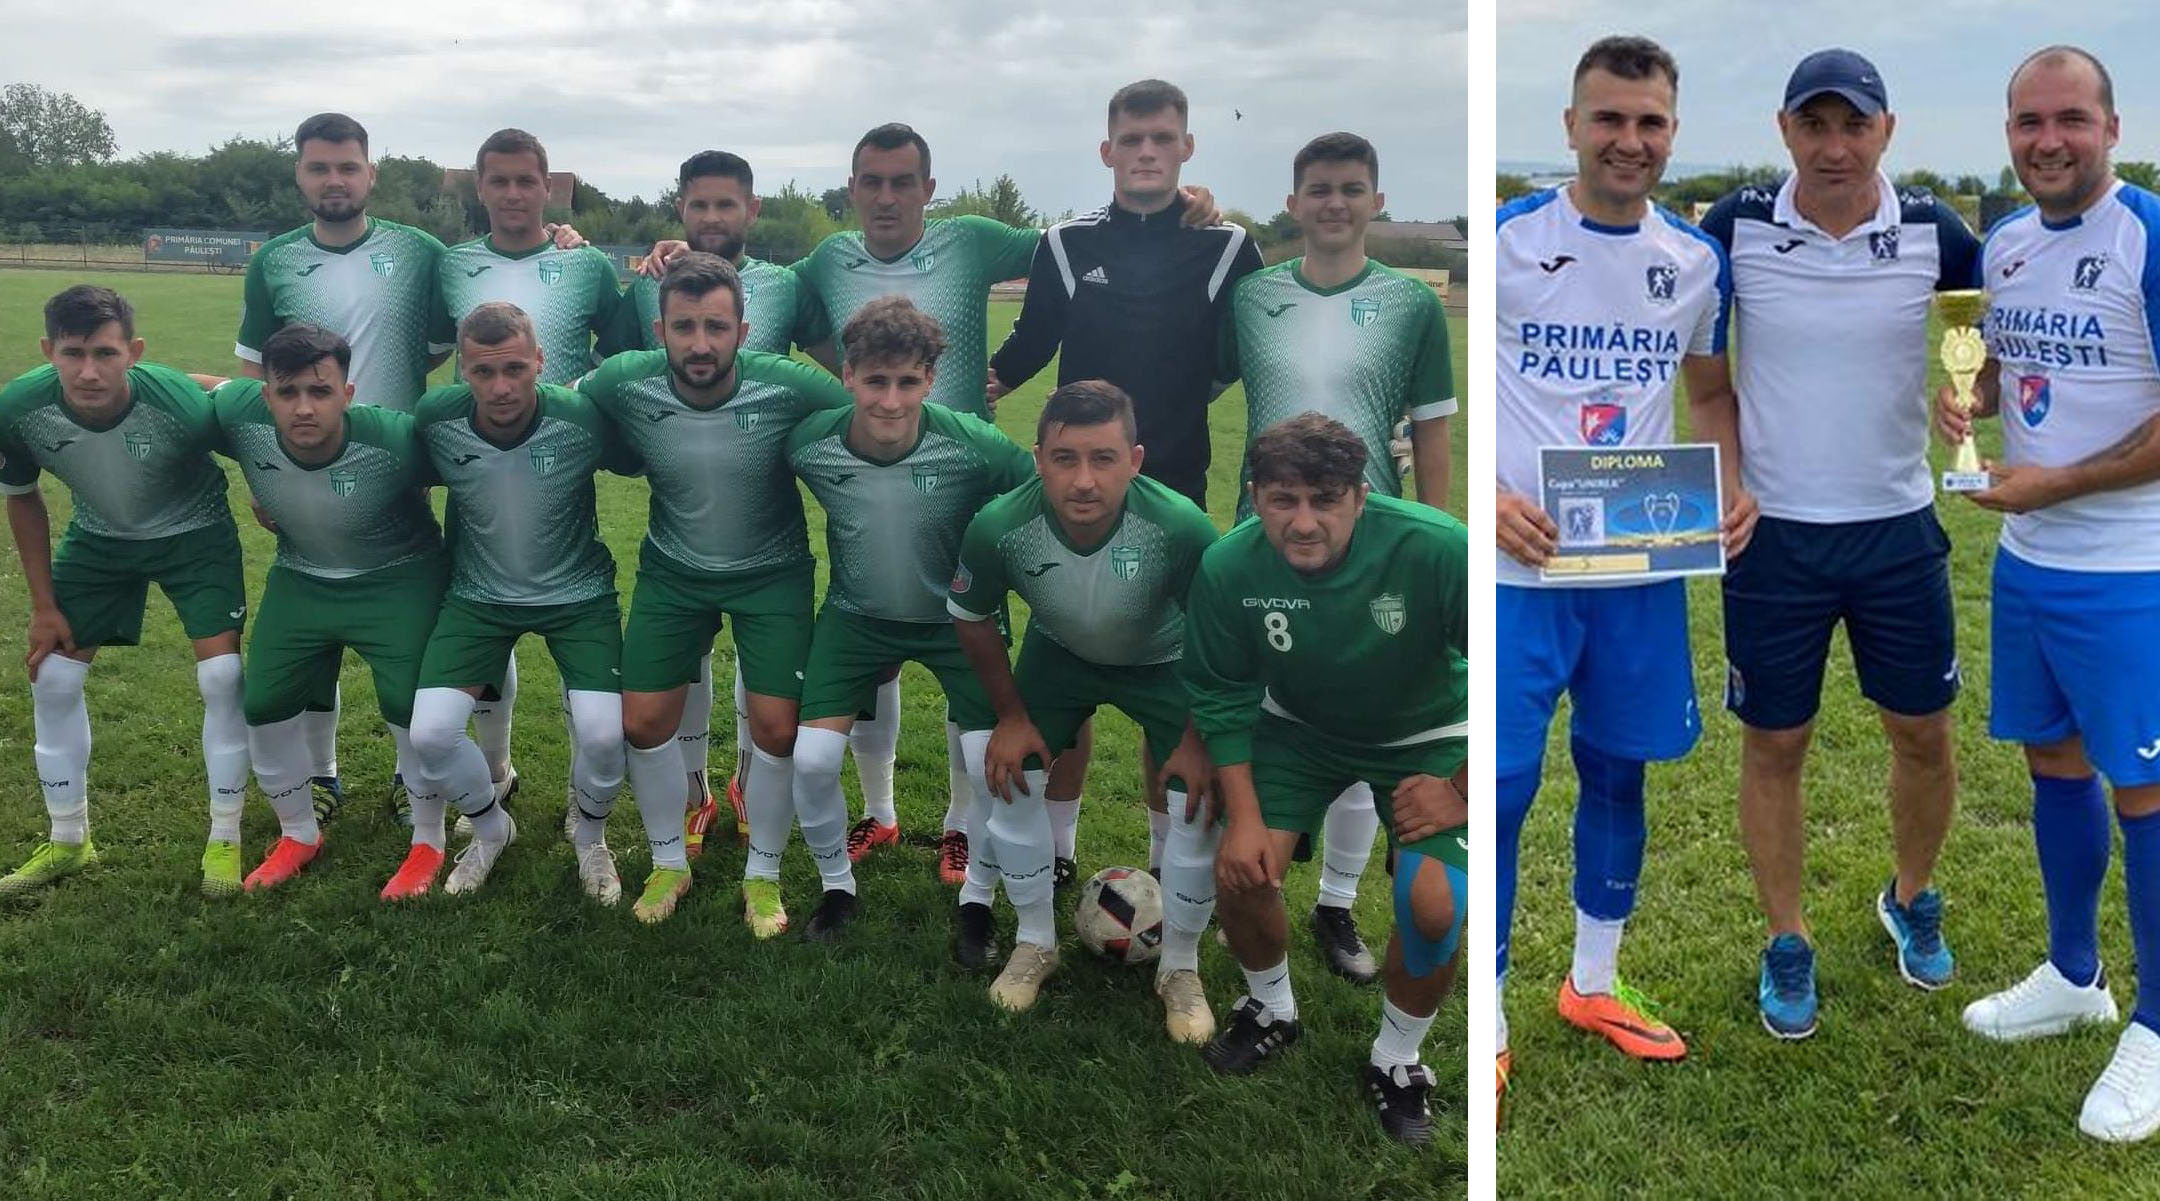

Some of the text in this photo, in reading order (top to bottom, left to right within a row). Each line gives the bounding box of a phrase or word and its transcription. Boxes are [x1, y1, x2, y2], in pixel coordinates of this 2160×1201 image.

[204, 237, 241, 246] COMUNEI
[1520, 322, 1679, 353] PRIMĂRIA
[1993, 307, 2105, 340] RIMĂRIA
[1994, 333, 2107, 368] ĂULEȘTI
[1590, 454, 1665, 471] DIPLOMA
[1242, 597, 1311, 610] GIVOVA
[1263, 611, 1293, 653] 8
